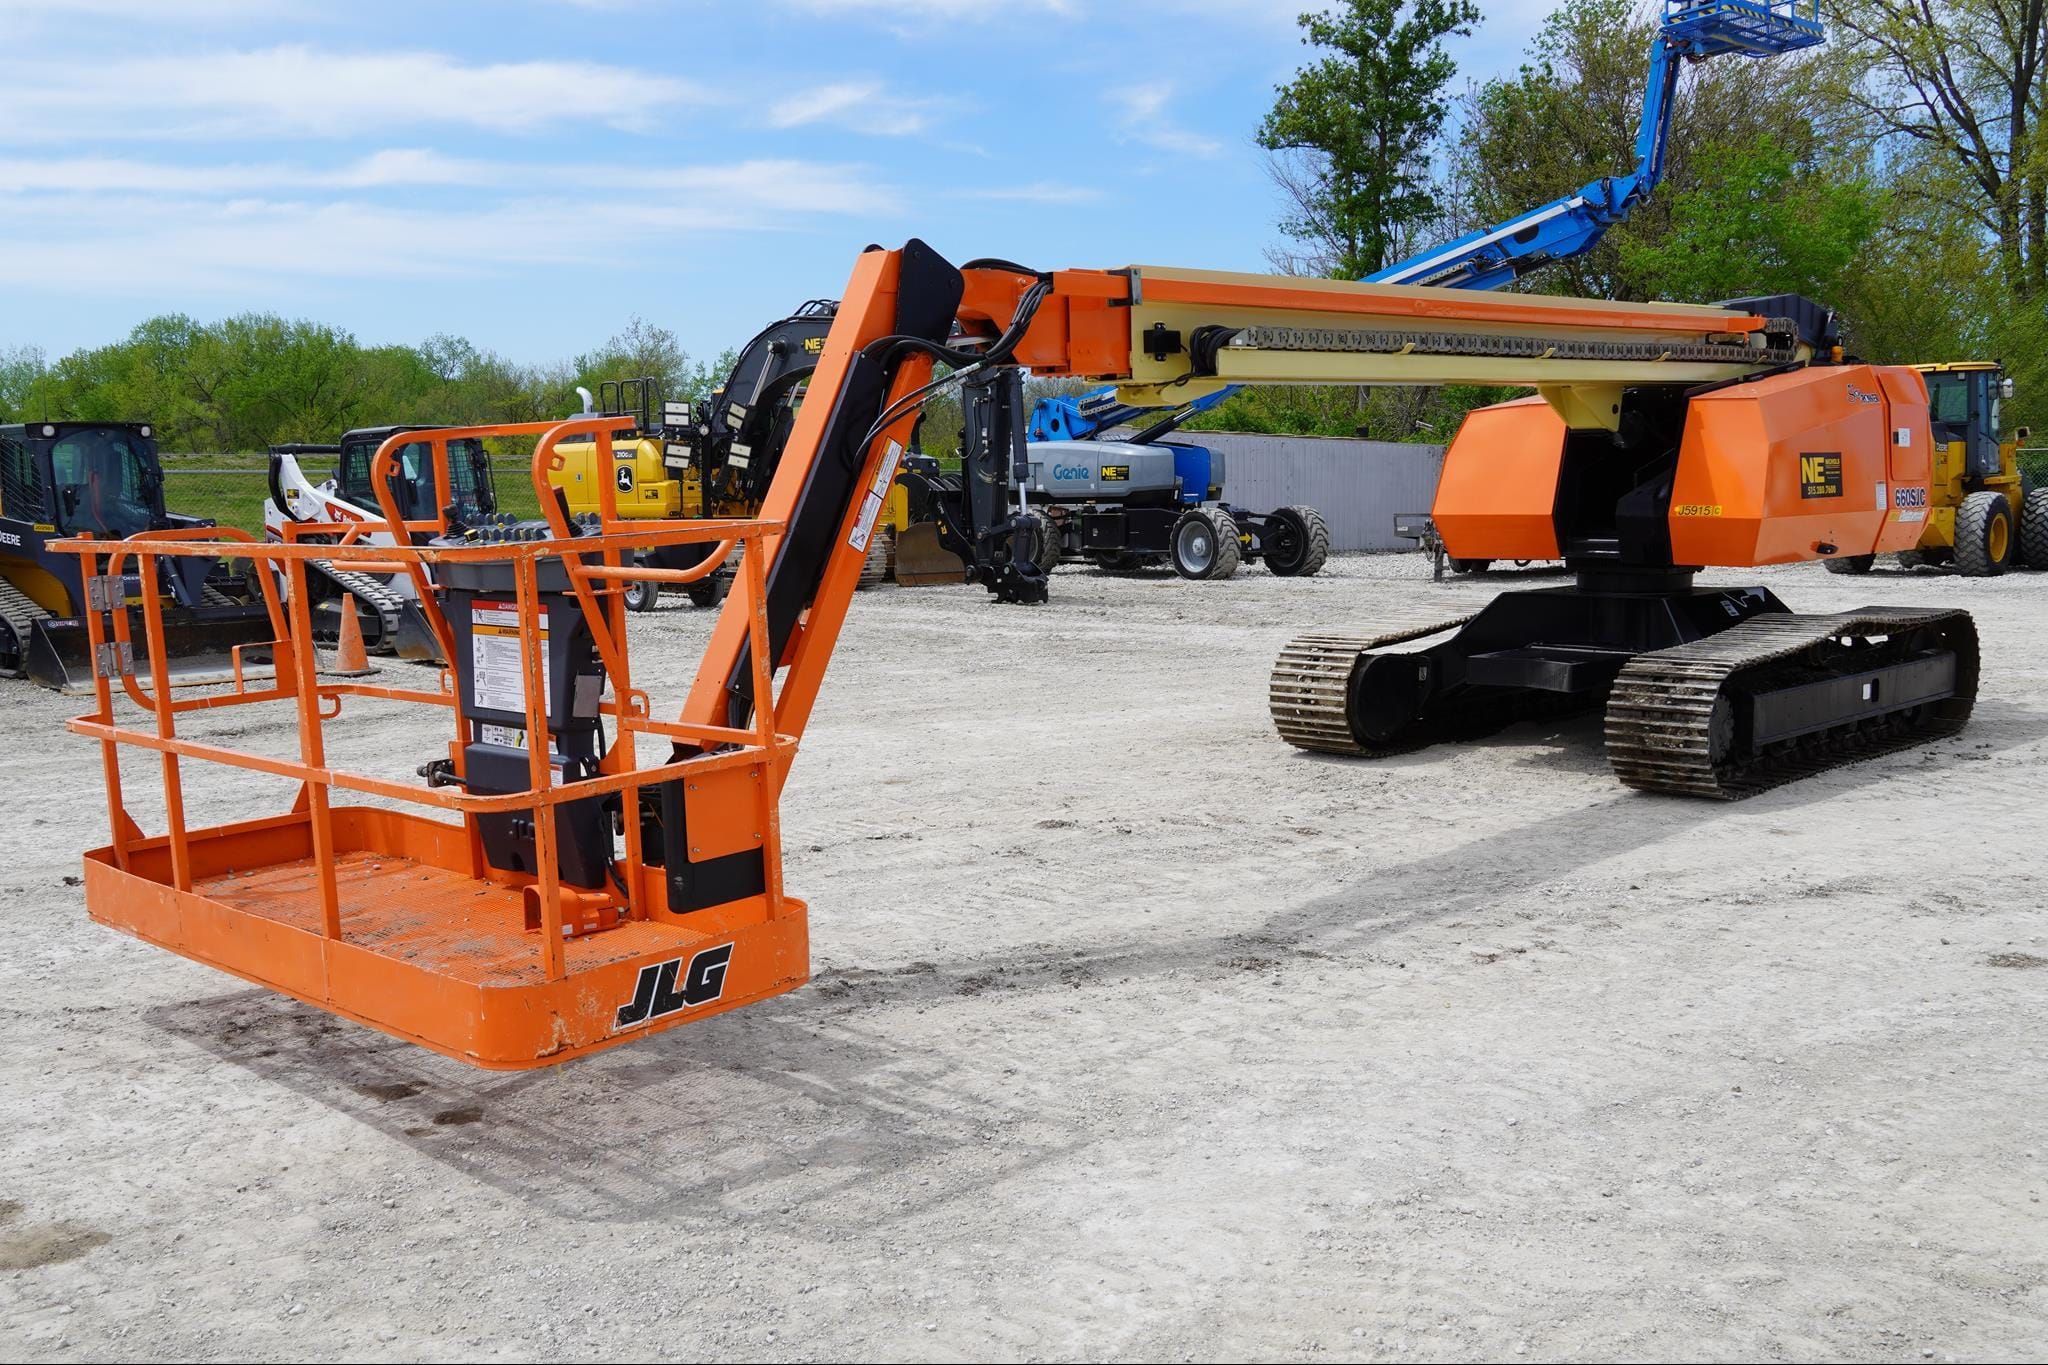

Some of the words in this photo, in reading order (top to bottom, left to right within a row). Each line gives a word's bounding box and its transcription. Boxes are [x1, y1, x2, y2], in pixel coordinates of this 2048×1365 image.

[1053, 463, 1089, 480] Genie
[1102, 466, 1117, 477] NE
[1801, 456, 1825, 484] NE
[1895, 488, 1926, 507] 660SJC
[1678, 505, 1711, 516] J5915
[613, 941, 735, 1031] JLG
